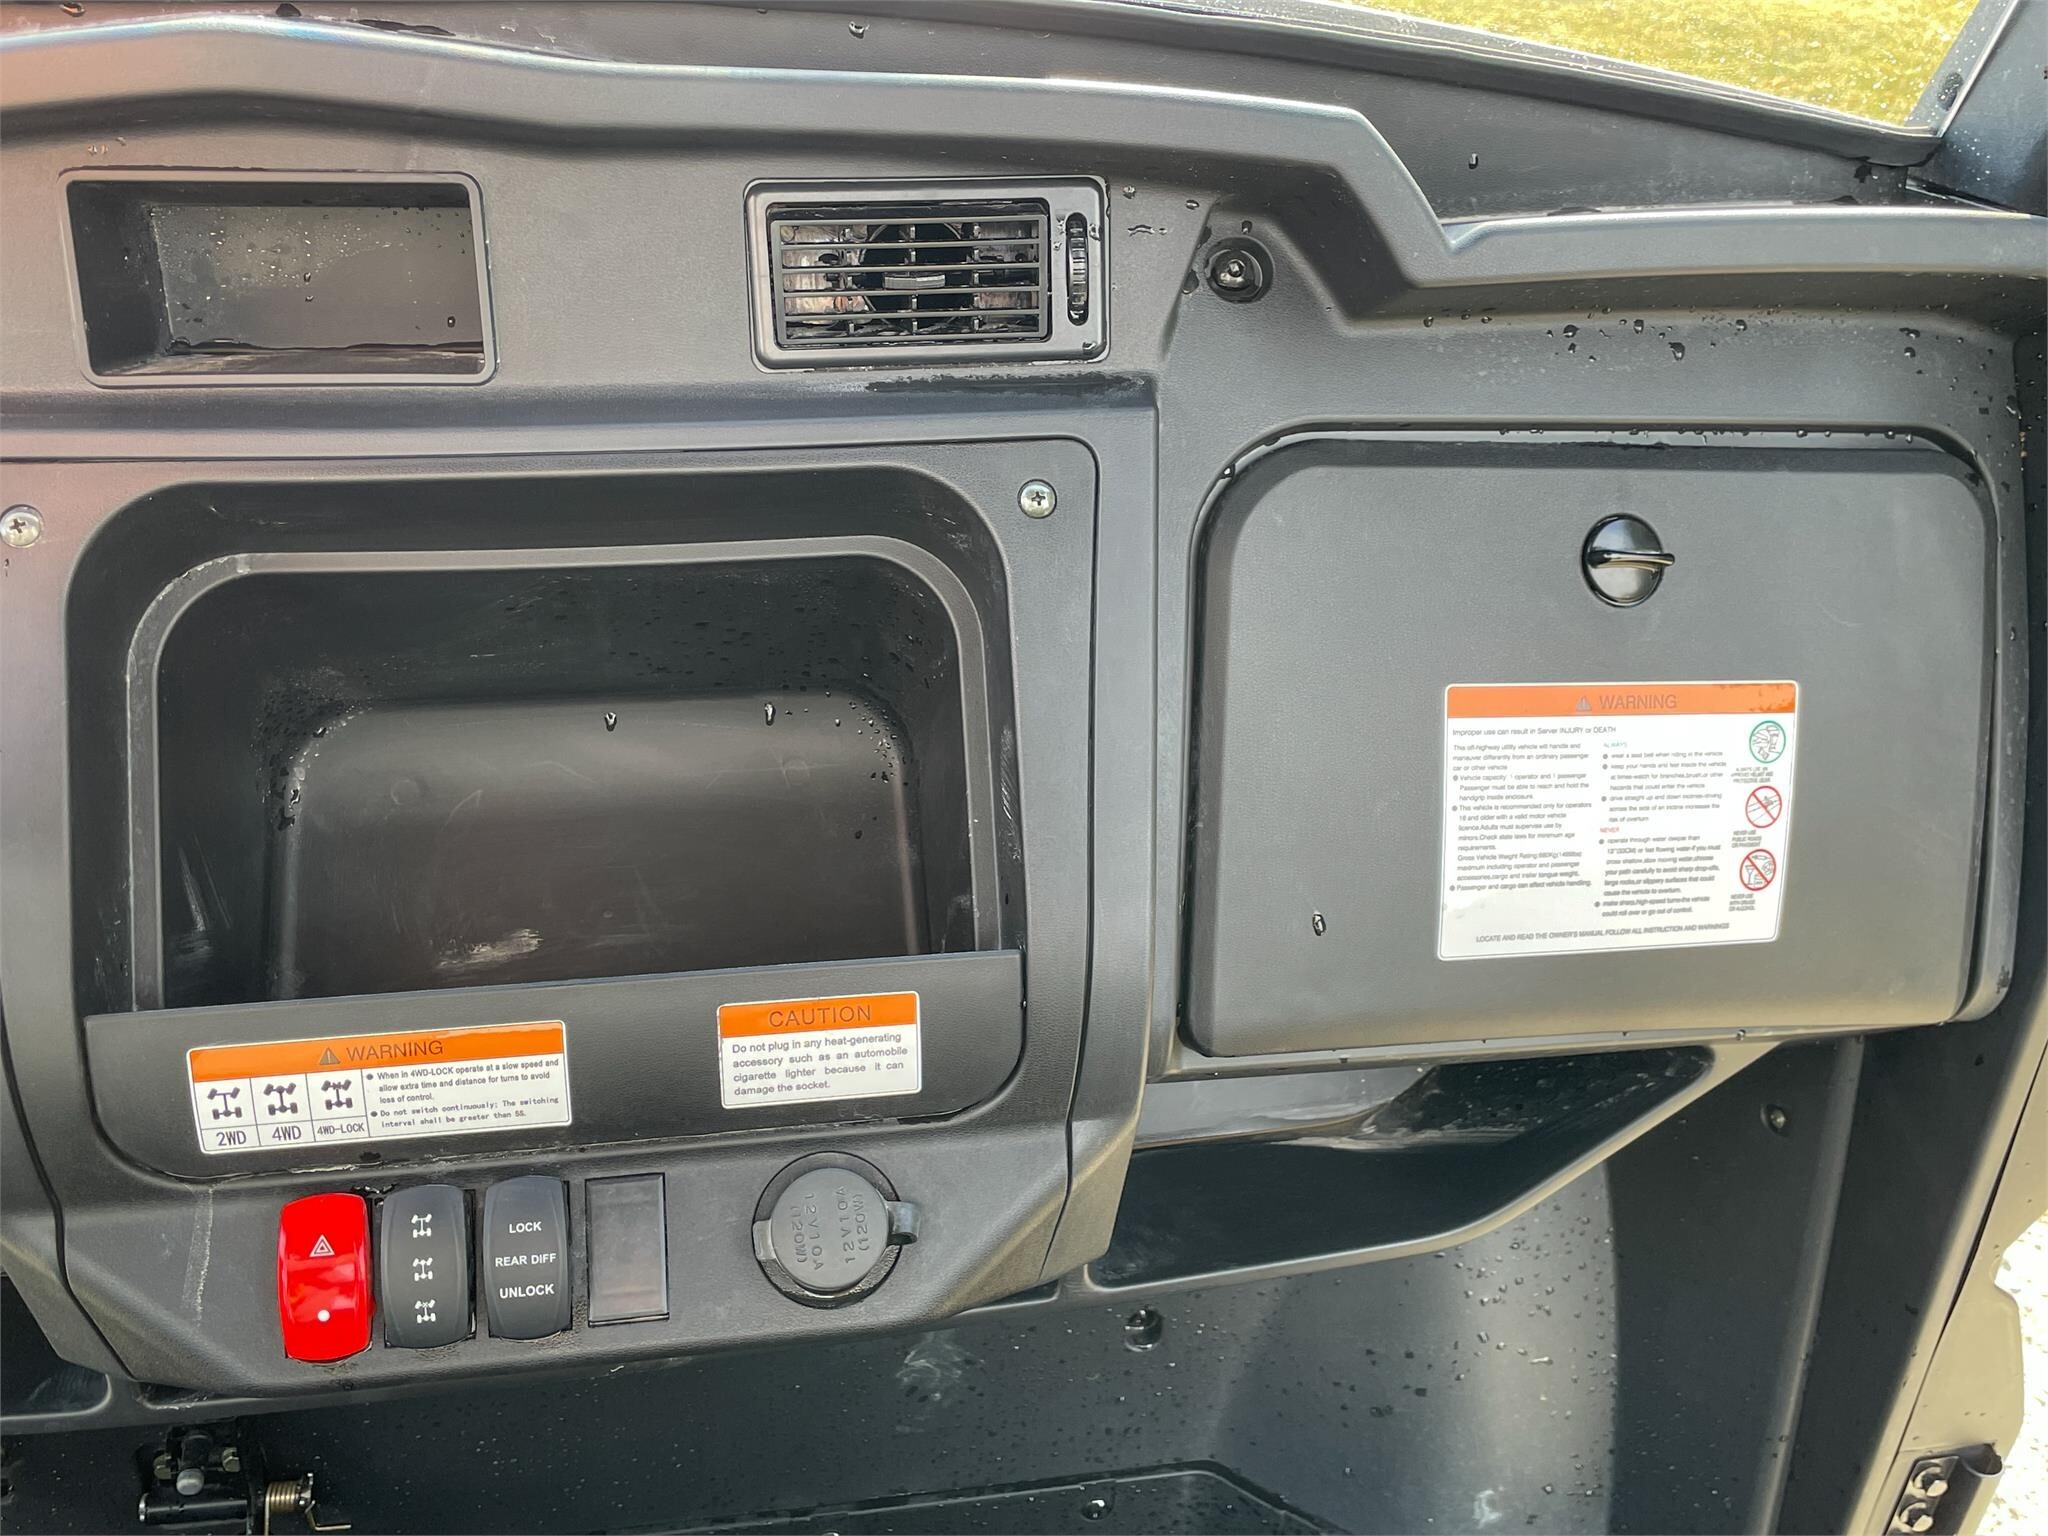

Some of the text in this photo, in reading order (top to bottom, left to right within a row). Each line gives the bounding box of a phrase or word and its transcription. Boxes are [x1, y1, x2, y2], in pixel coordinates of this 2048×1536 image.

[1598, 694, 1678, 709] WARNING
[1559, 726, 1584, 734] INJURY
[769, 1005, 870, 1028] CAUTION
[346, 1039, 443, 1062] WARNING
[732, 1032, 901, 1054] Do not plug in any heat-generating
[733, 1057, 784, 1069] accessory
[789, 1053, 813, 1064] such
[836, 1052, 849, 1060] an
[854, 1046, 908, 1059] automobile
[377, 1071, 399, 1080] When
[401, 1070, 408, 1078] in
[410, 1066, 454, 1078] 4WD-LOCK
[455, 1065, 484, 1075] operate
[486, 1064, 494, 1072] at
[502, 1062, 519, 1070] slow
[520, 1060, 543, 1070] speed
[545, 1058, 559, 1067] and
[733, 1062, 904, 1084] cigarette lighter because it can
[379, 1071, 550, 1092] allow extra time and distance for turns to avoid
[734, 1080, 830, 1097] damage the socket.
[379, 1096, 395, 1104] loss
[396, 1095, 405, 1103] of
[380, 1109, 390, 1117] Do
[393, 1108, 408, 1116] not
[411, 1106, 438, 1114] switch
[502, 1099, 516, 1107] The
[520, 1096, 559, 1106] switching
[382, 1119, 415, 1128] interval
[420, 1116, 442, 1125] shall
[446, 1115, 456, 1123] be
[459, 1114, 490, 1123] greater
[493, 1111, 512, 1119] than
[272, 1125, 302, 1141] 4WD
[317, 1122, 365, 1136] 4WD-LOCK
[216, 1130, 247, 1147] 2WD
[509, 1221, 542, 1234] LOCK
[834, 1185, 856, 1264] 12V10A
[852, 1193, 870, 1252] (120W)
[495, 1252, 556, 1267] REAR DIFF
[499, 1284, 554, 1299] UNLOCK
